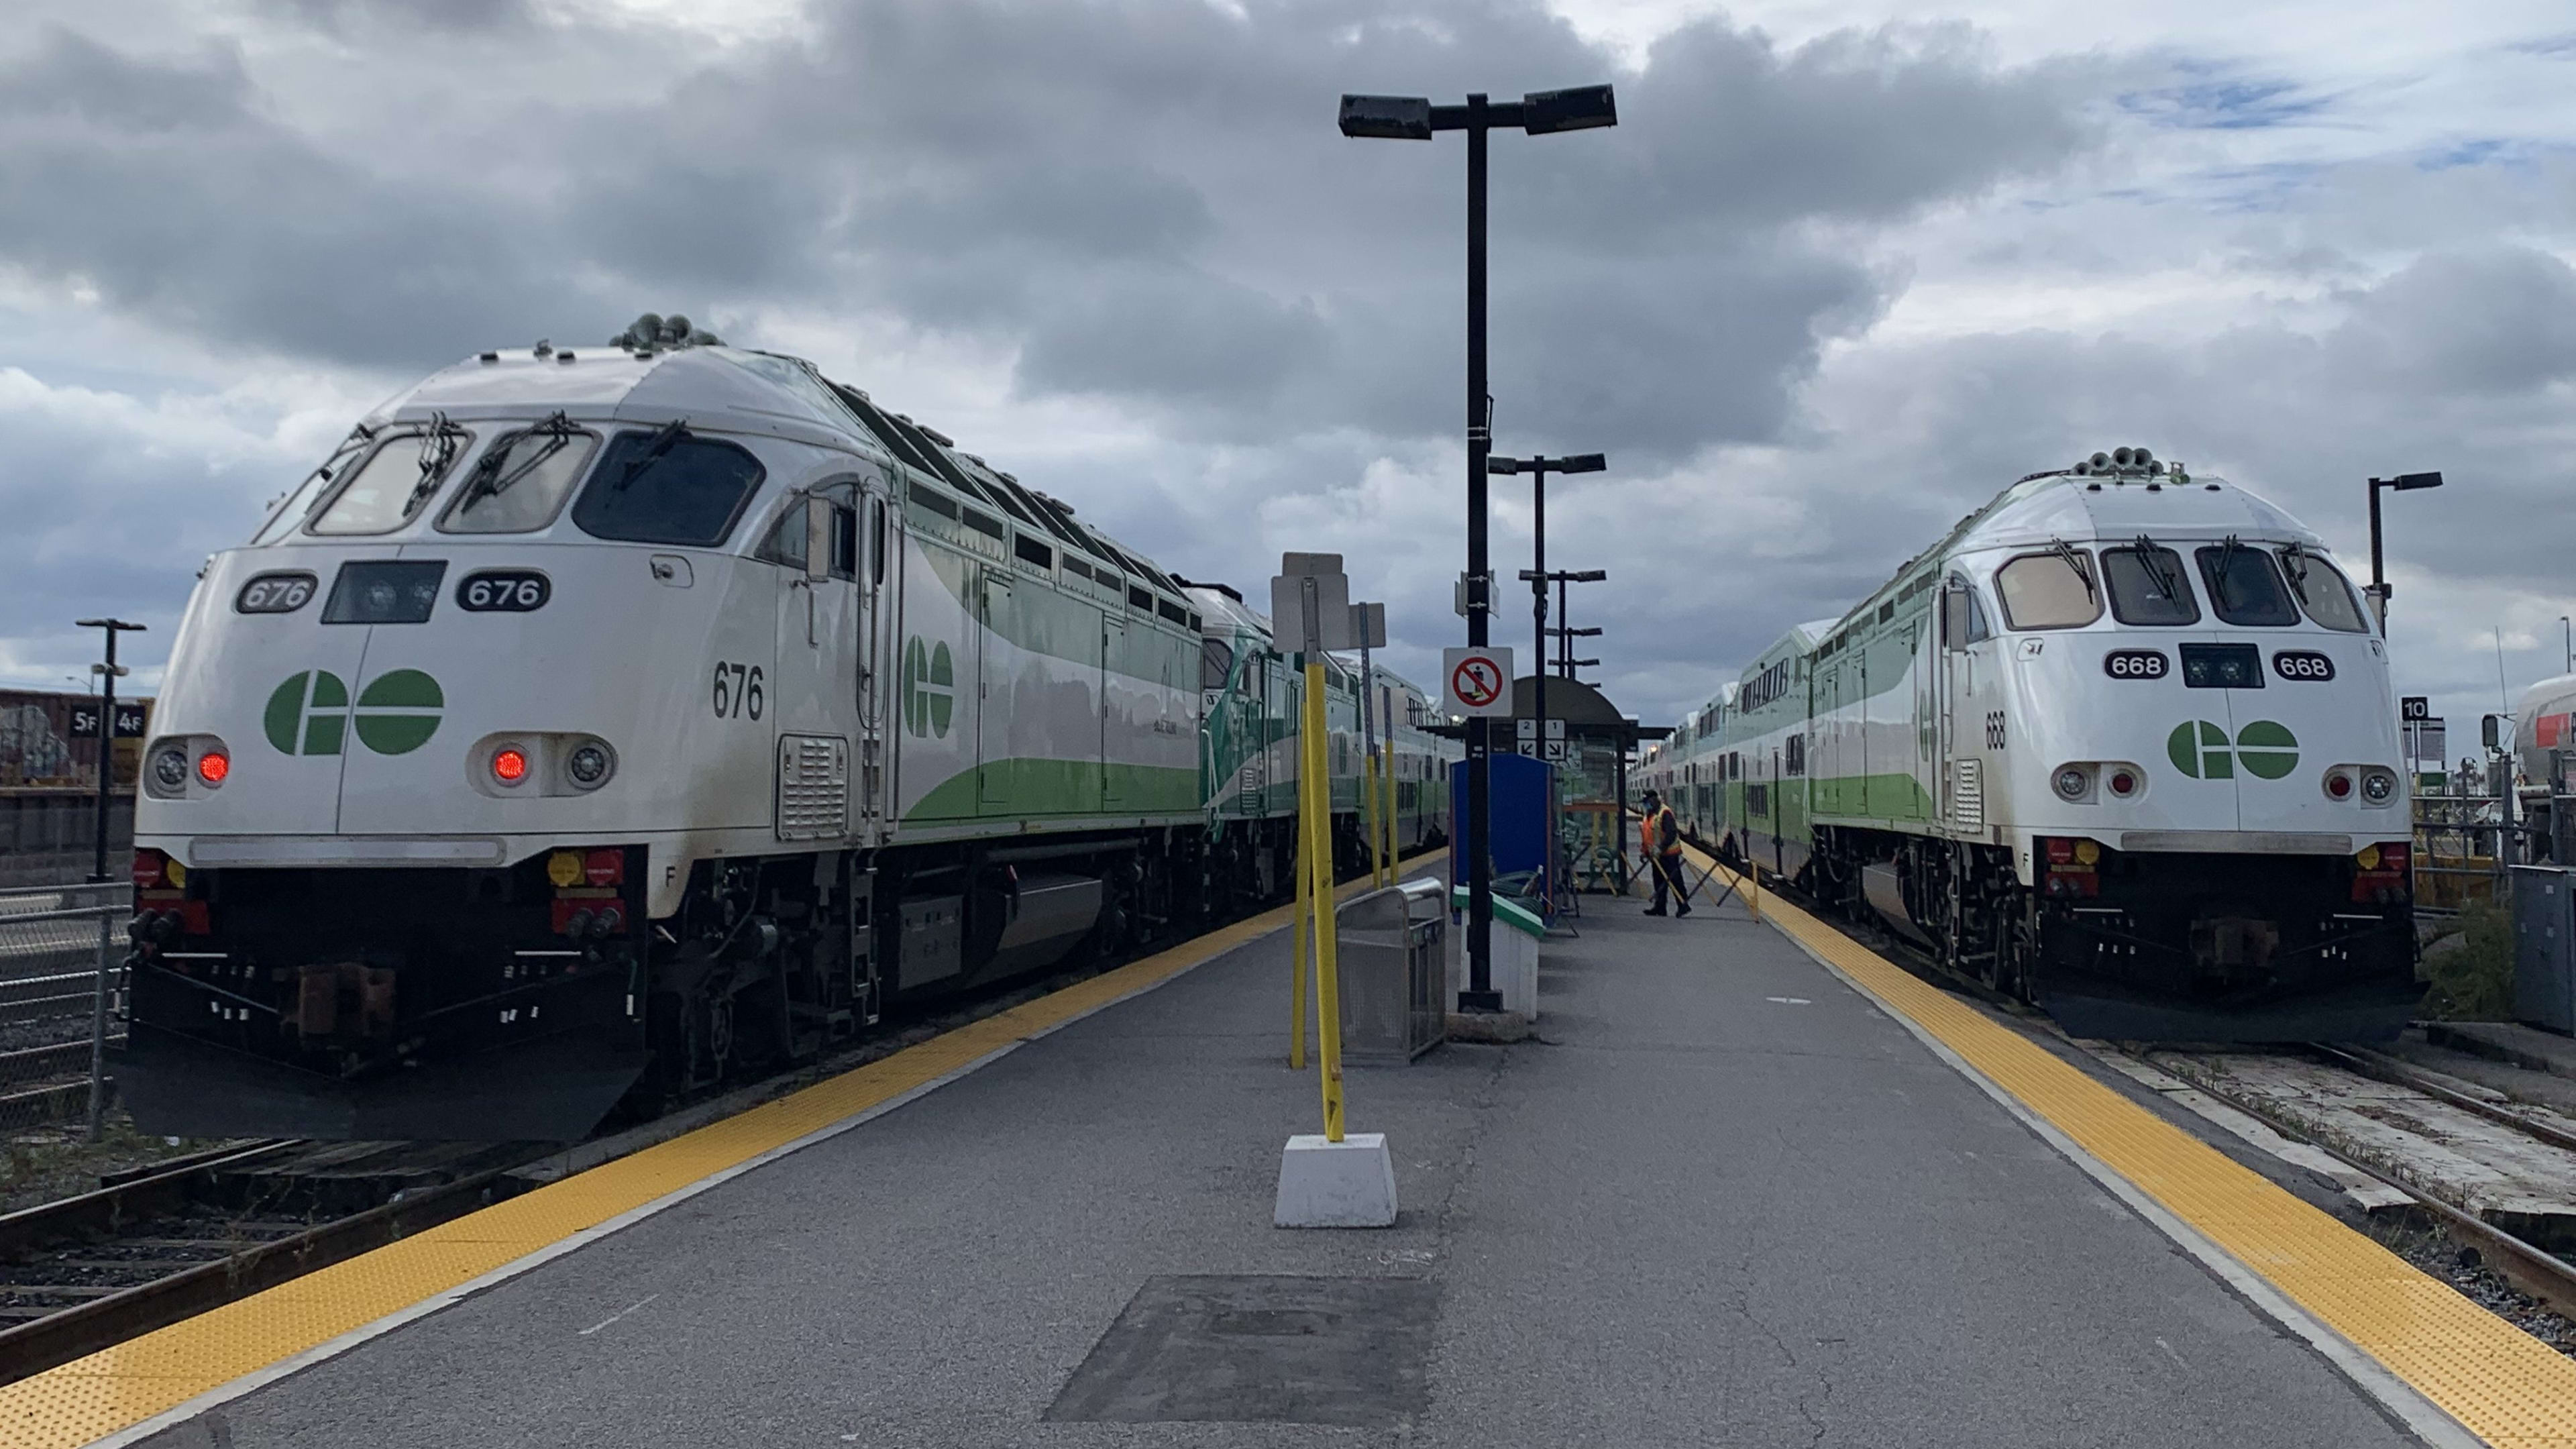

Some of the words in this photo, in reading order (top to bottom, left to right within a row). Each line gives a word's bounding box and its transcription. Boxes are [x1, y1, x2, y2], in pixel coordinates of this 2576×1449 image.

[246, 581, 309, 607] 676
[469, 580, 540, 605] 676
[2112, 657, 2162, 675] 668
[2280, 658, 2329, 676] 668
[713, 661, 763, 721] 676
[2405, 702, 2426, 716] 10
[74, 712, 97, 731] 5F
[119, 712, 142, 731] 4F
[1523, 721, 1530, 730] 2
[1986, 710, 2005, 750] 668
[665, 866, 676, 887] F
